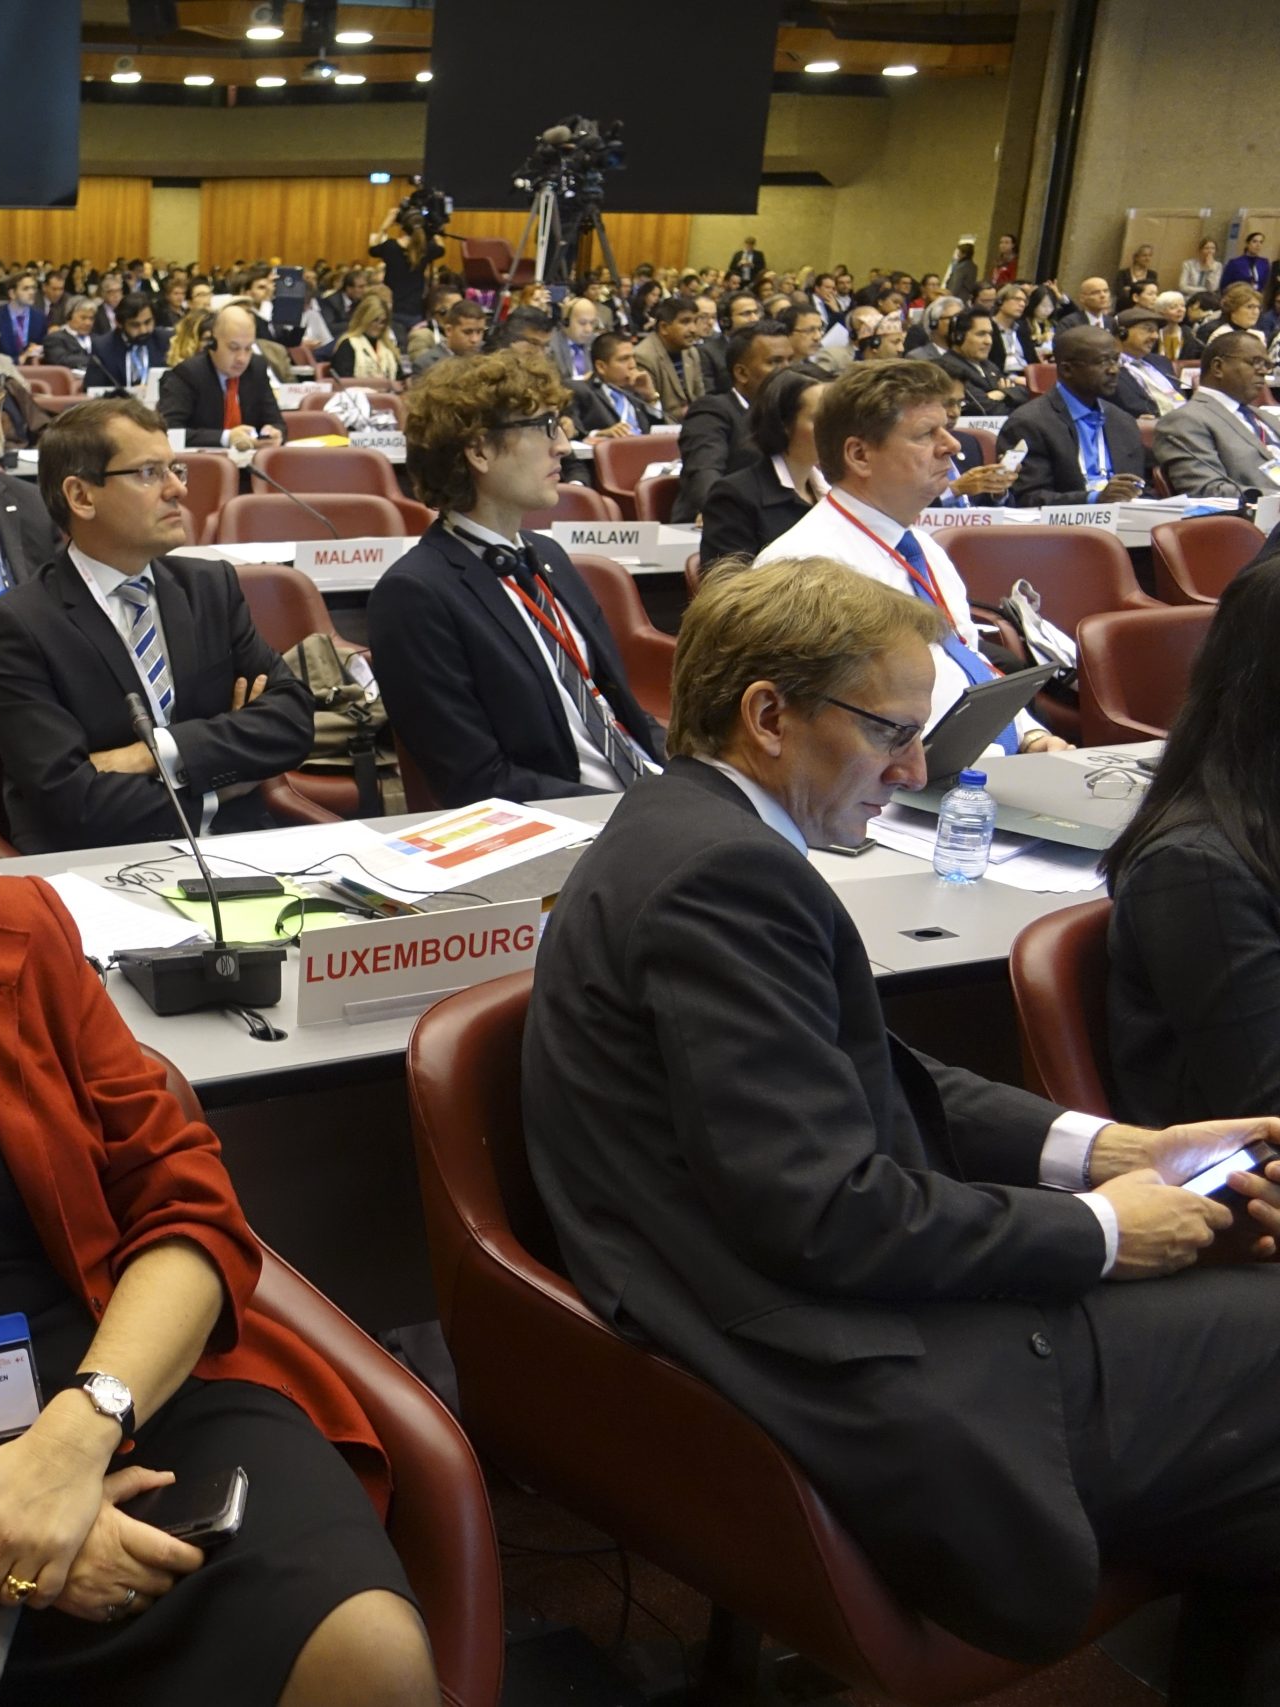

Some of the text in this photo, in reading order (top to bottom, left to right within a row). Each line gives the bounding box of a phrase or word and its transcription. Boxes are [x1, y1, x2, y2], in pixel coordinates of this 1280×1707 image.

[968, 420, 1000, 430] NEPAL
[1048, 511, 1112, 526] MALDIVES
[570, 530, 639, 545] MALAWI
[314, 548, 384, 565] MALAWI
[306, 924, 535, 983] LUXEMBOURG
